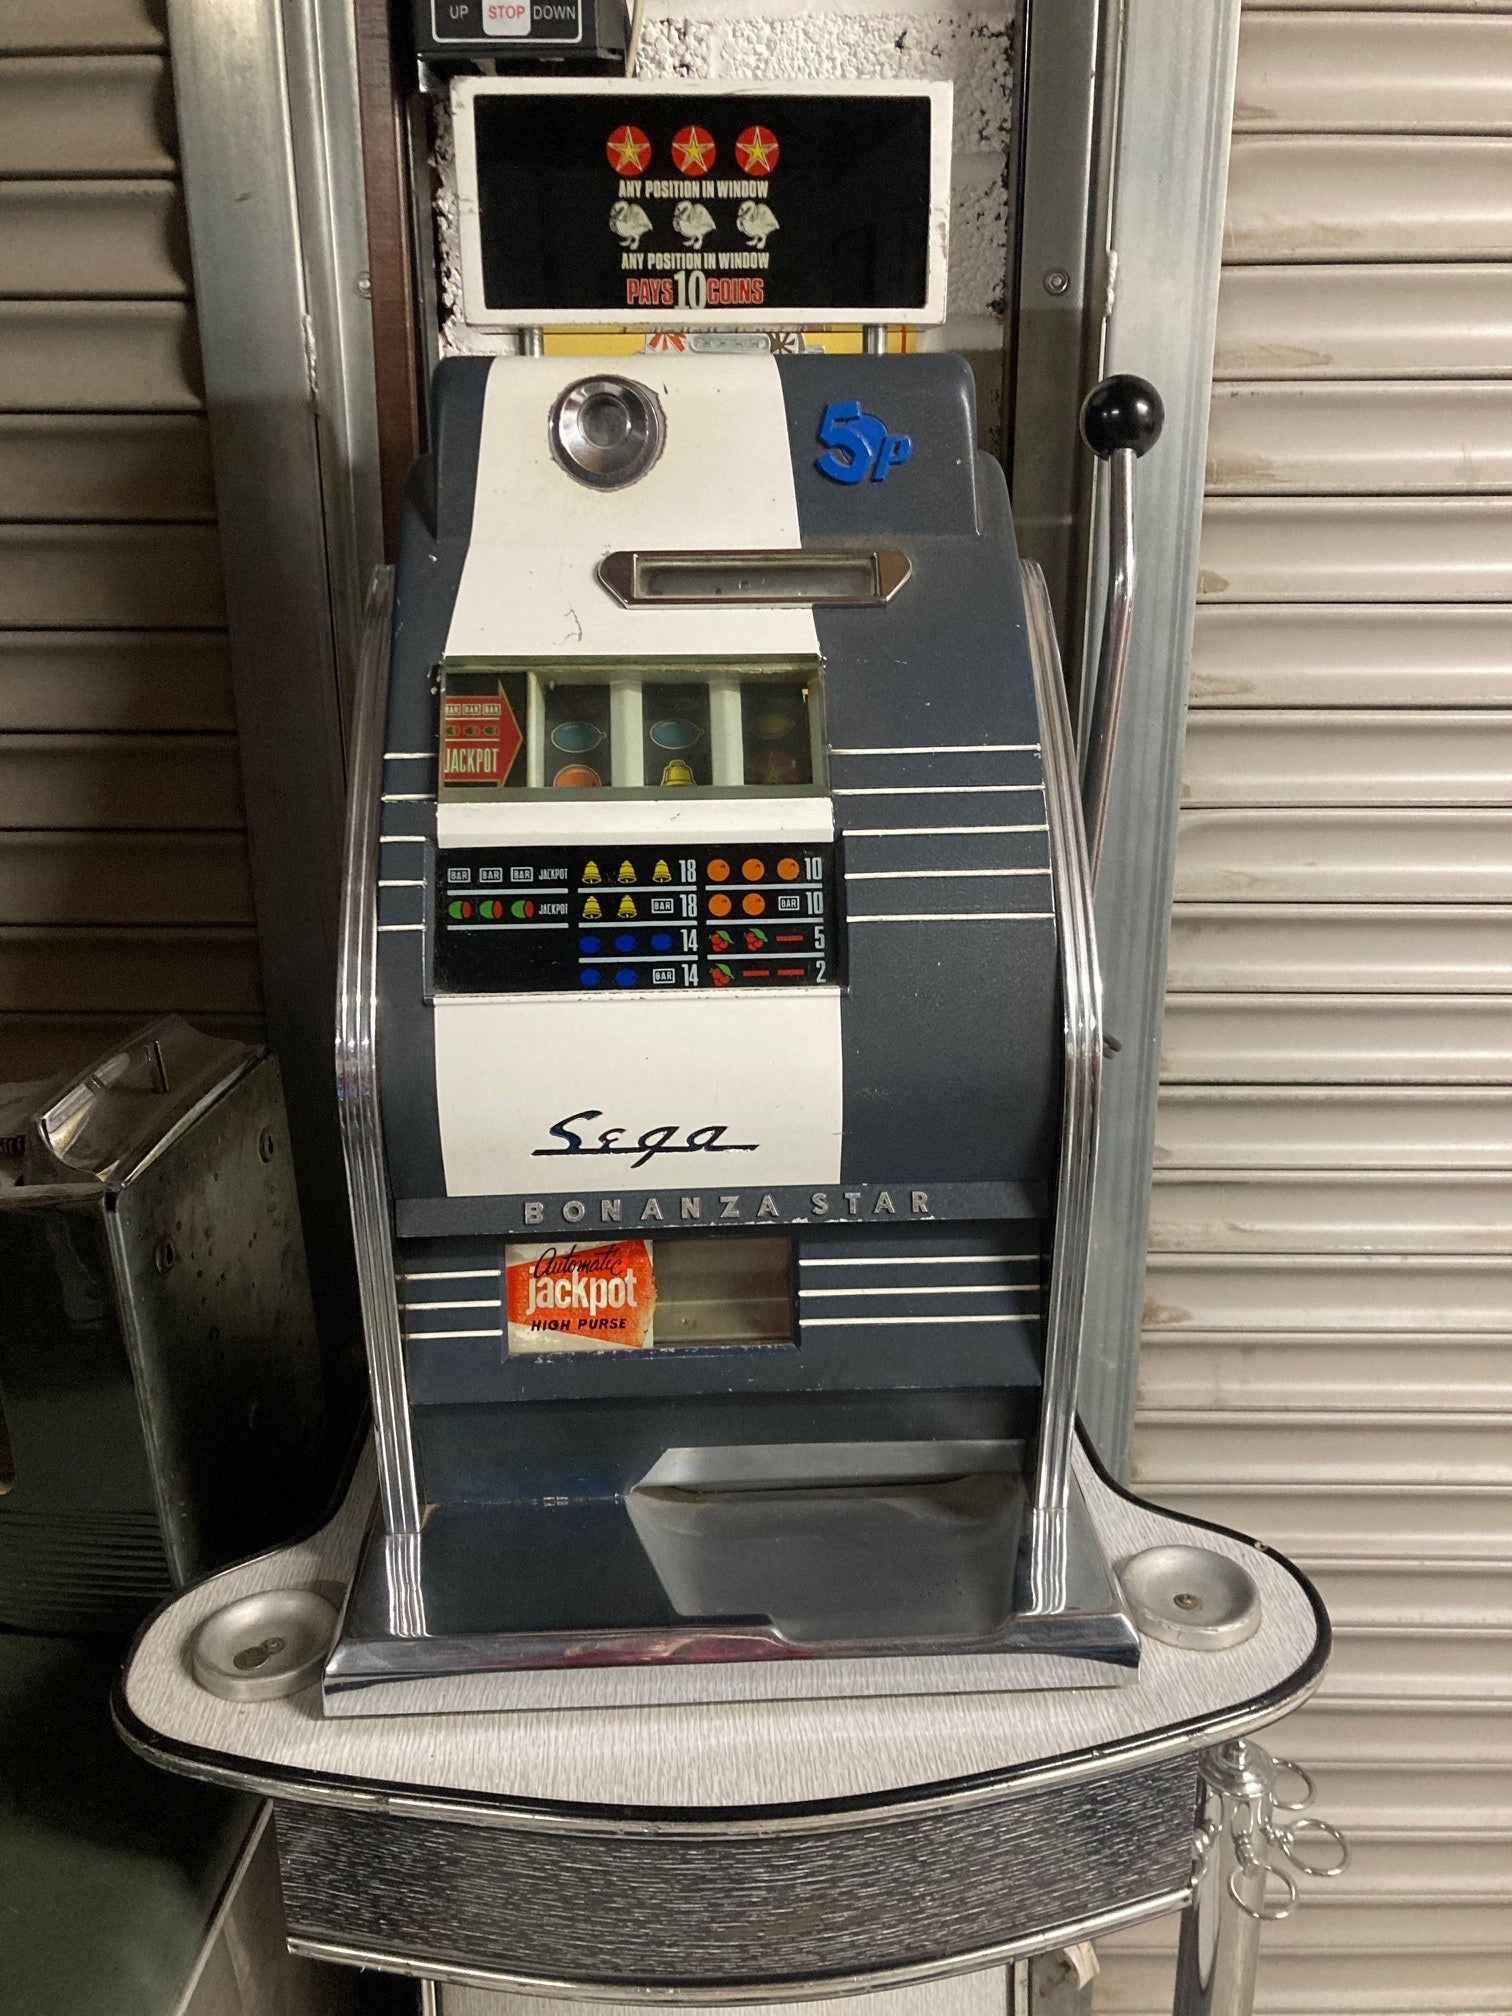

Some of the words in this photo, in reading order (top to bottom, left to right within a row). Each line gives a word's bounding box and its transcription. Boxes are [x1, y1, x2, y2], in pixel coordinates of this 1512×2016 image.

[449, 5, 469, 19] UP
[488, 5, 525, 19] STOP
[533, 5, 576, 20] DOWN
[618, 180, 642, 198] ANY
[645, 180, 700, 198] POSITION
[702, 180, 714, 198] IN
[717, 180, 769, 198] WINDOW
[621, 253, 644, 270] ANY
[647, 253, 700, 270] POSITION
[704, 253, 716, 270] IN
[718, 253, 770, 270] WINDOW
[626, 278, 674, 305] PAYS
[673, 270, 707, 310] 10
[706, 277, 764, 305] COINS
[443, 748, 499, 773] JACKPOT
[450, 870, 469, 881] BAR
[481, 870, 500, 880] BAR
[513, 869, 532, 879] BAR
[538, 868, 569, 880] JACKPOT
[679, 859, 697, 882] 18
[804, 857, 822, 880] 10
[538, 903, 569, 915] JACKPOT
[653, 900, 672, 911] BAR
[679, 894, 697, 917] 18
[780, 898, 797, 909] BAR
[806, 892, 823, 914] 10
[680, 929, 698, 952] 14
[814, 926, 826, 949] 5
[655, 970, 673, 981] BAR
[682, 964, 698, 986] 14
[815, 960, 827, 983] 2
[531, 1109, 760, 1168] Sega
[523, 1194, 779, 1225] BONANZA
[811, 1190, 930, 1215] STAR
[533, 1244, 623, 1279] Automatic
[525, 1264, 638, 1316] jackpot
[531, 1319, 571, 1331] HIGH
[577, 1318, 627, 1330] PURSE
